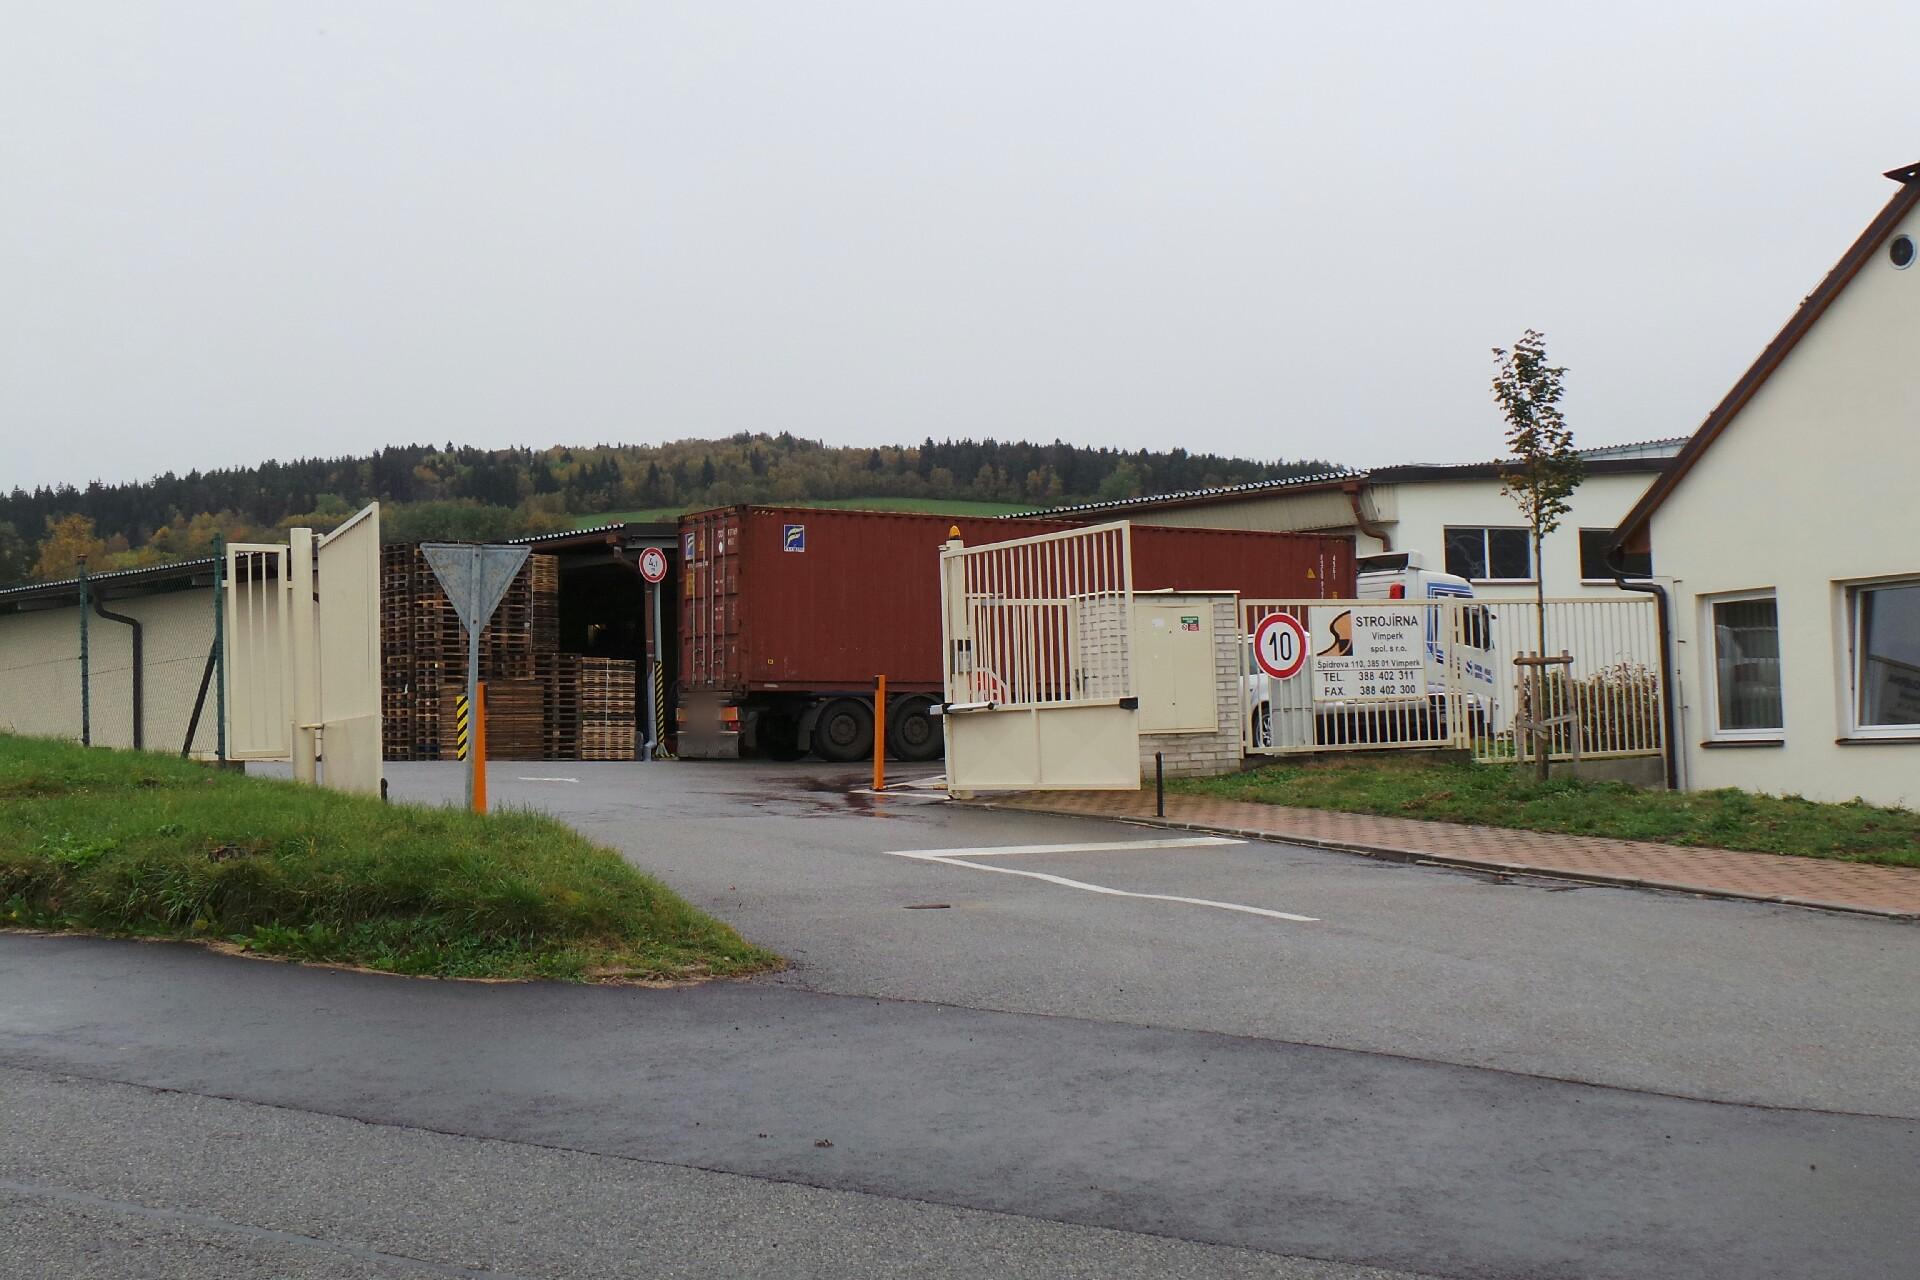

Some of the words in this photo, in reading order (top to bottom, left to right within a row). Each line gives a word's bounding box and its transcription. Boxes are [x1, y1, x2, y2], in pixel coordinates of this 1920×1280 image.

[1355, 613, 1418, 627] STROJÍRNA
[1371, 631, 1404, 642] Vimperk
[1268, 631, 1292, 661] 10
[1370, 645, 1388, 654] spol.
[1367, 659, 1380, 668] 385
[1381, 659, 1389, 667] 01
[1391, 658, 1420, 668] Vimperk
[1323, 672, 1344, 682] TEL.
[1358, 671, 1375, 681] 388
[1378, 671, 1394, 681] 402
[1398, 670, 1414, 680] 311
[1324, 686, 1346, 696] FAX.
[1359, 685, 1376, 695] 388
[1379, 685, 1396, 695] 402
[1399, 684, 1416, 694] 300
